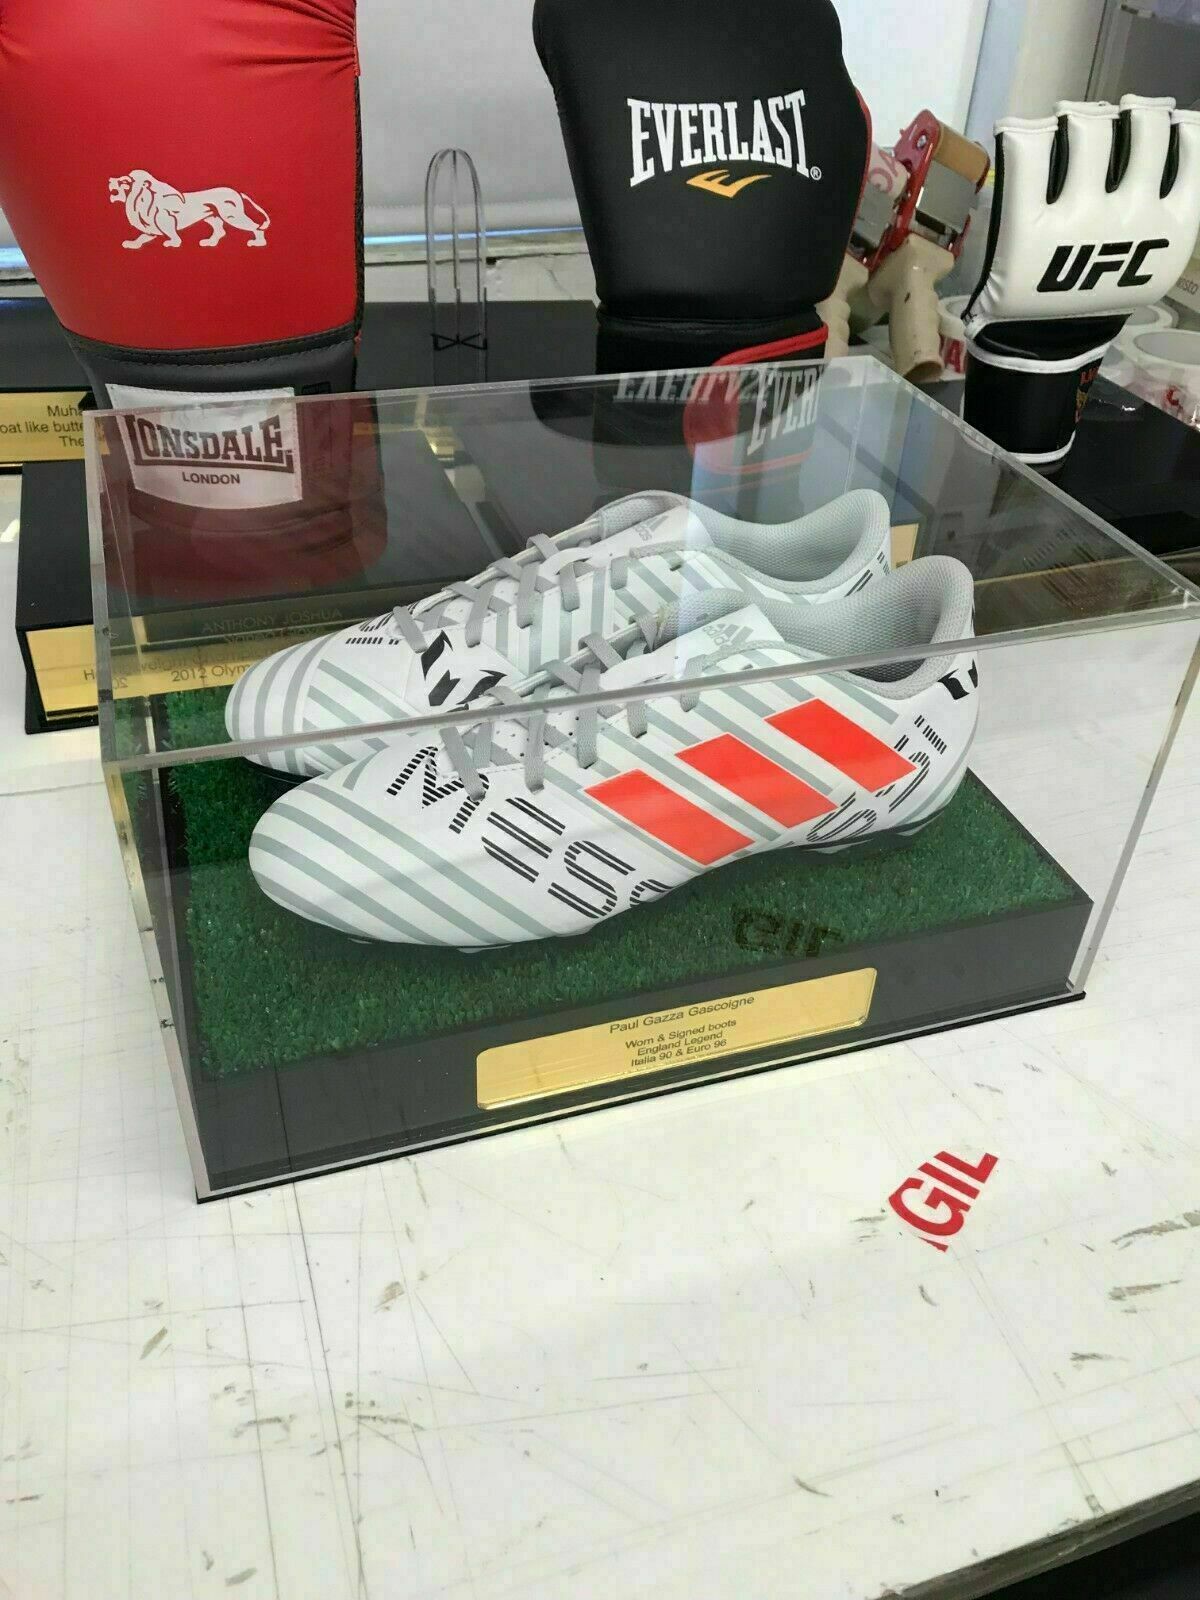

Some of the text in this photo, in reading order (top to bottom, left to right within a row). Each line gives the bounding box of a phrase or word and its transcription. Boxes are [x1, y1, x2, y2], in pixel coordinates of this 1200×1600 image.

[627, 89, 810, 187] EVERLAST
[1036, 238, 1170, 292] UFC
[25, 421, 49, 432] like
[122, 414, 295, 473] LONSDALE
[182, 471, 241, 484] LONDON
[171, 666, 207, 682] 2012
[609, 996, 755, 1033] Paul Gazza Gascoigne
[625, 1019, 737, 1049] Worn & Signed boots
[637, 1031, 723, 1056] England Legend
[631, 1057, 656, 1067] Italia
[659, 1051, 673, 1060] 90
[675, 1049, 684, 1057] &
[686, 1043, 711, 1055] Euro
[888, 1151, 999, 1253] GIL
